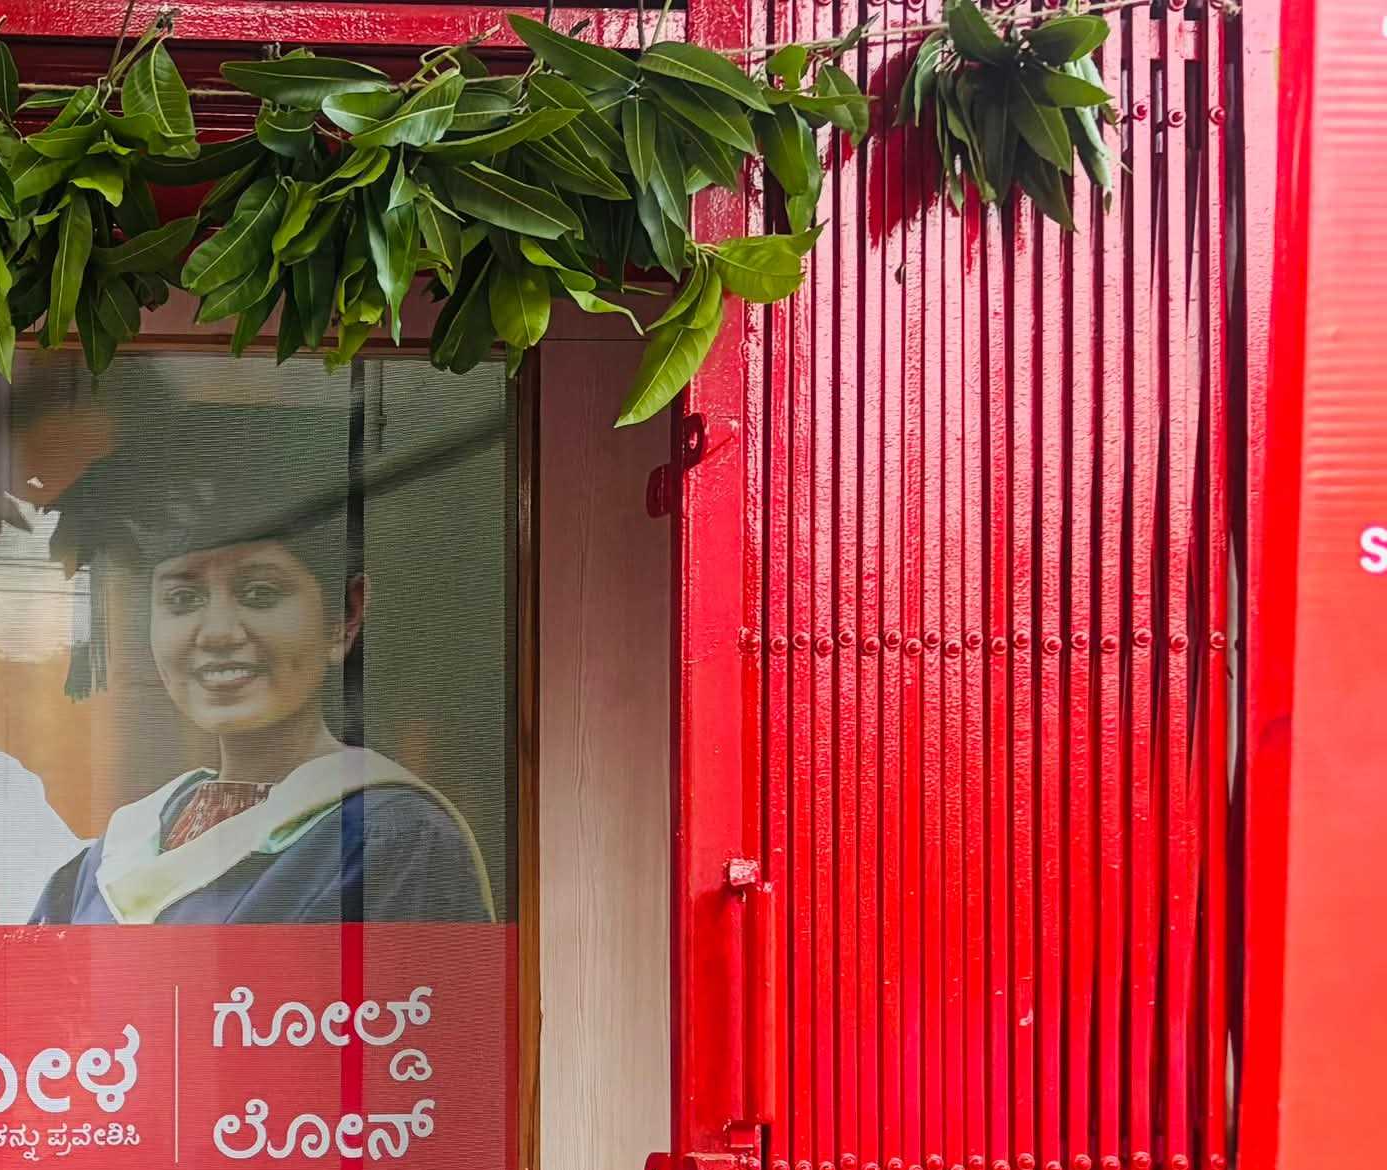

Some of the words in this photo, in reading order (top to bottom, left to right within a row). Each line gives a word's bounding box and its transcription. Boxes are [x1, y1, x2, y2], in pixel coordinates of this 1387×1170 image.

[213, 986, 433, 1081] ಗೋಲ್ಡ್
[47, 1122, 140, 1156] ಪ್ರವೇಶಿಸಿ
[213, 1098, 435, 1160] ಲೋನ್
